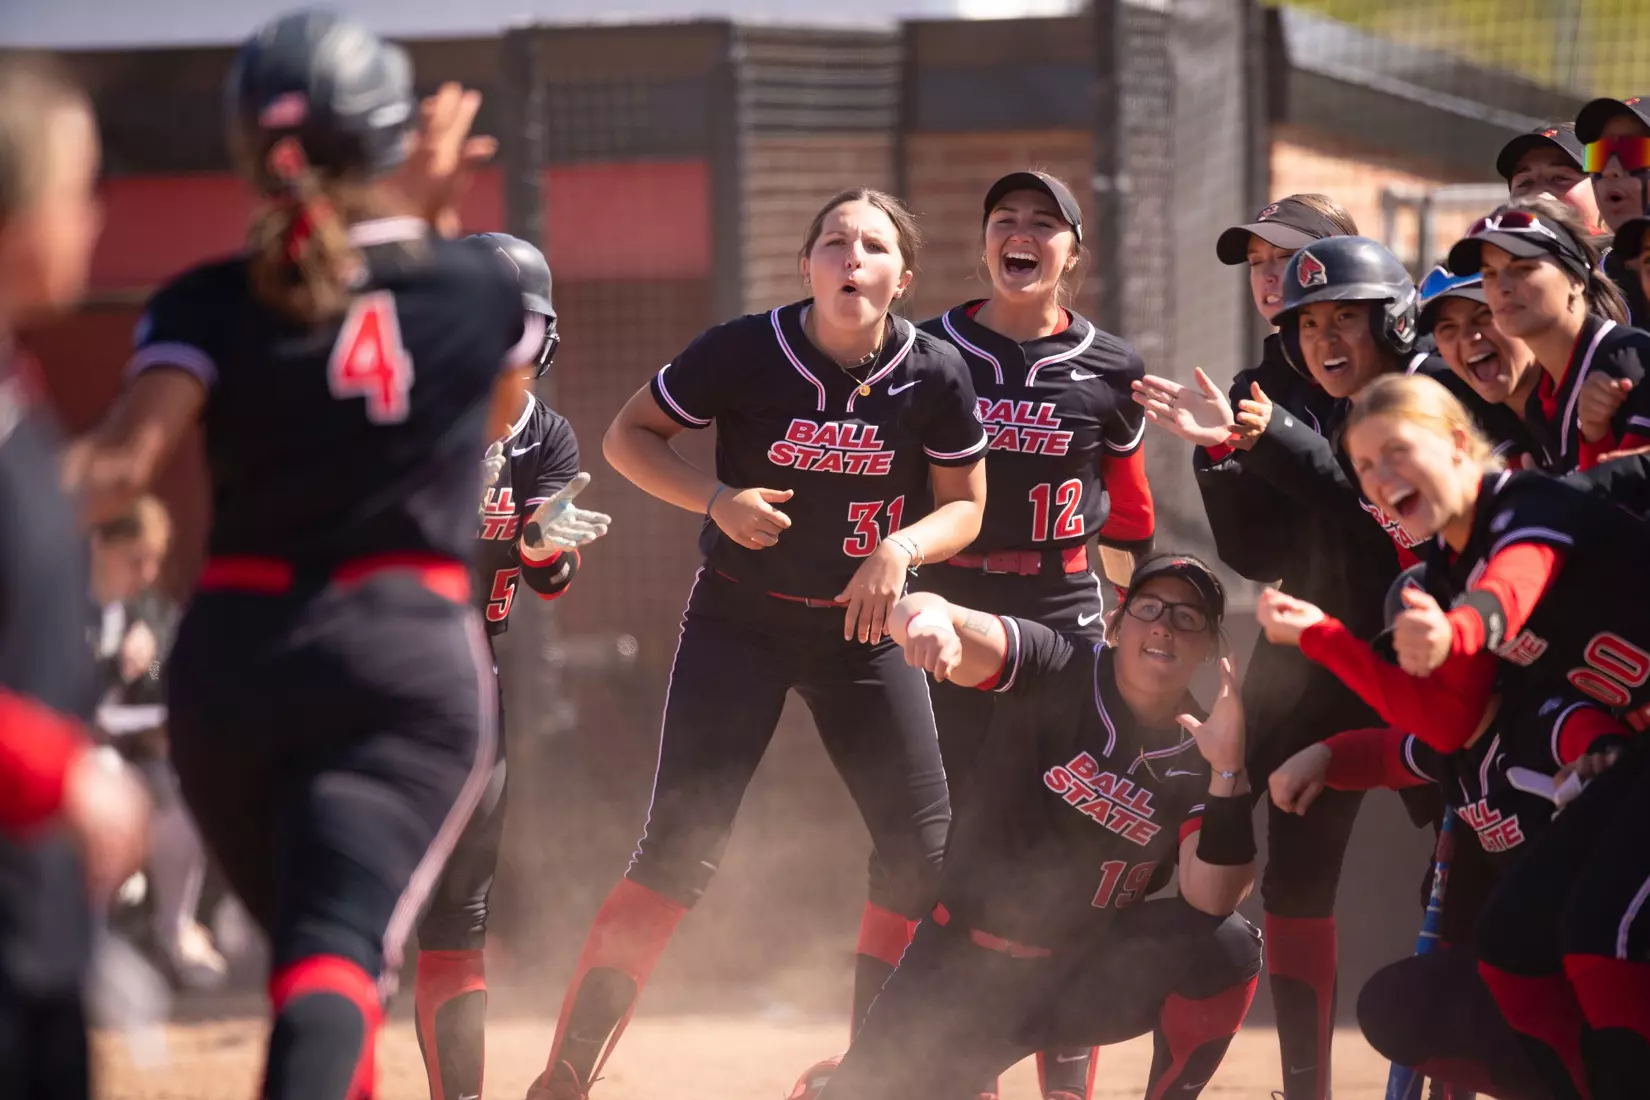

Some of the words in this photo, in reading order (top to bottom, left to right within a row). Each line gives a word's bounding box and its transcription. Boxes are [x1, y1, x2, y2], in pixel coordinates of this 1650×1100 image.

[327, 289, 415, 424] 4
[767, 441, 895, 475] STATE
[785, 418, 884, 450] BALL
[983, 425, 1074, 456] ATE
[843, 495, 905, 557] 31
[1029, 478, 1084, 541] 12
[486, 567, 521, 622] 5
[1566, 631, 1650, 707] 00
[1043, 766, 1162, 846] STATE
[1065, 751, 1156, 818] BALL
[1091, 860, 1158, 908] 19
